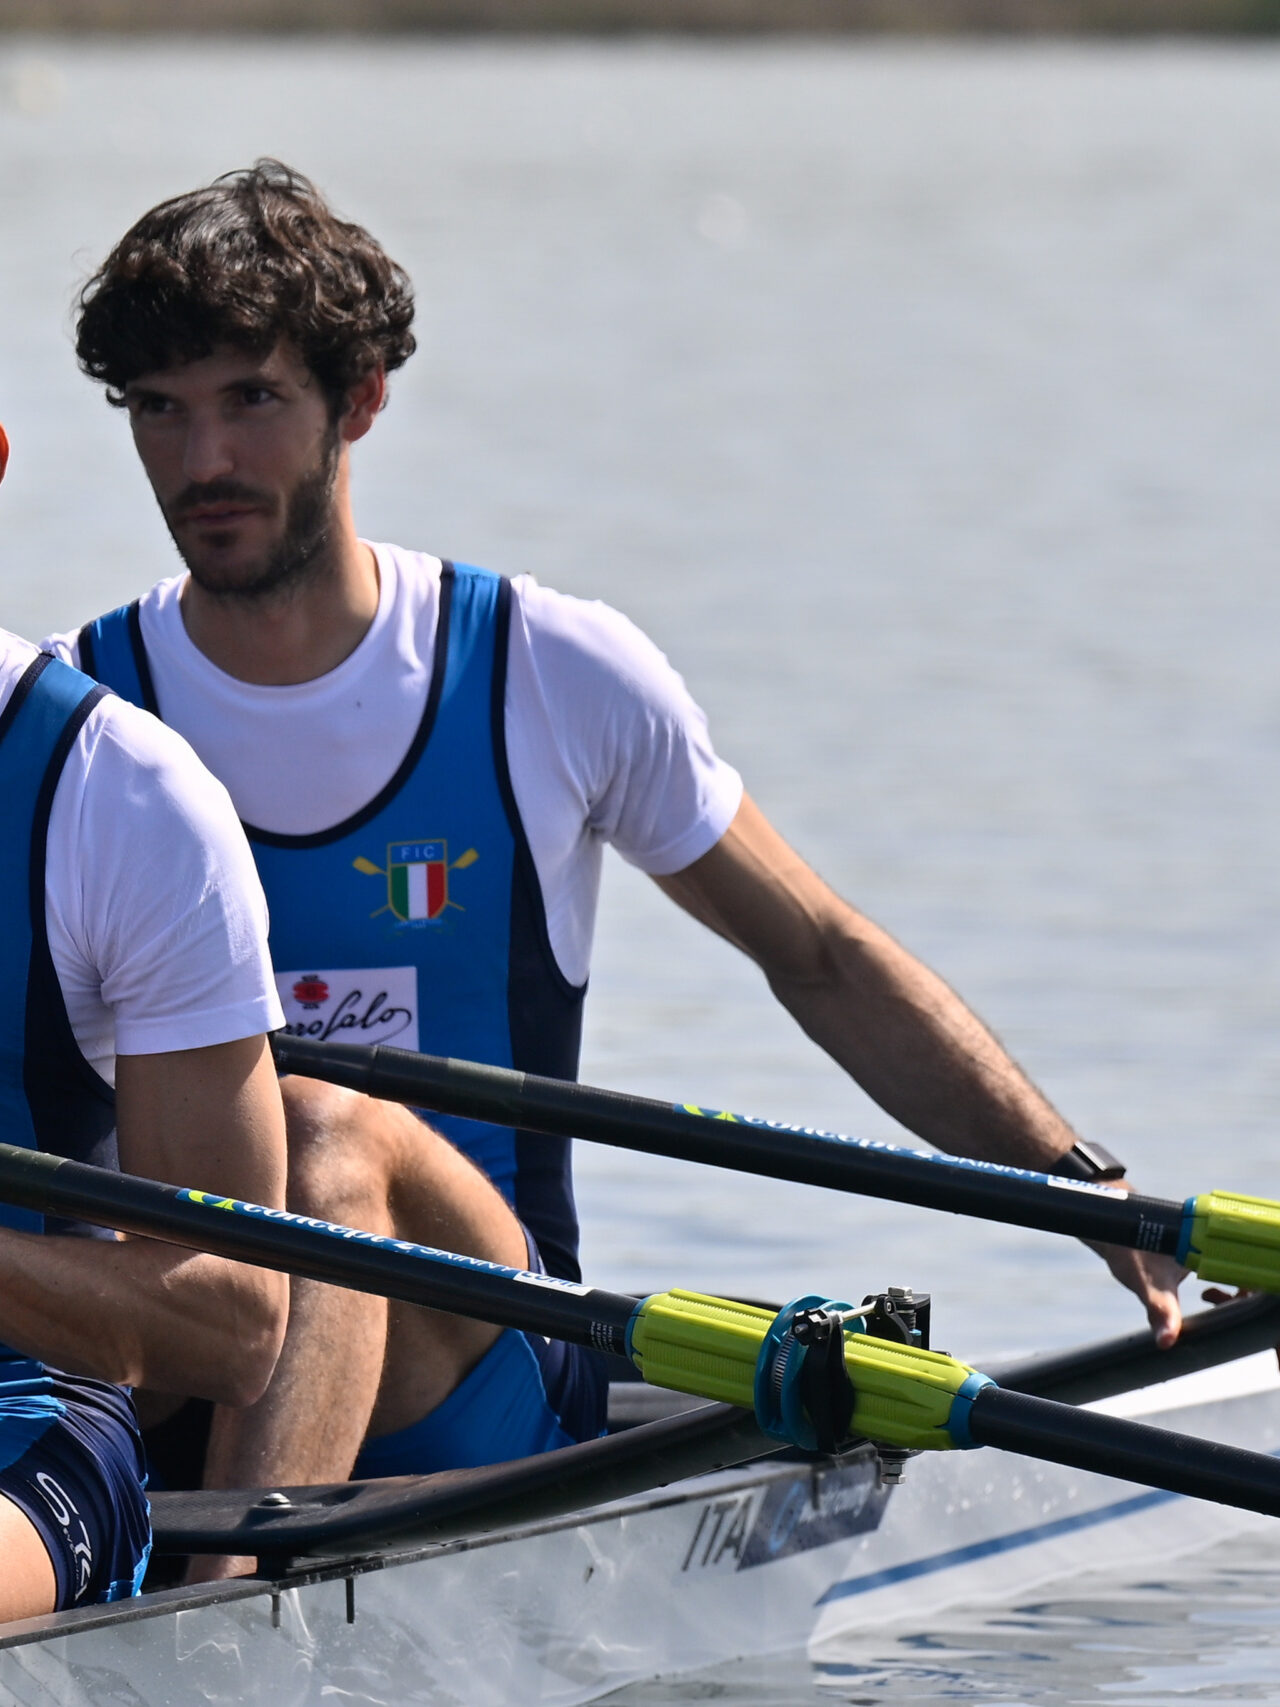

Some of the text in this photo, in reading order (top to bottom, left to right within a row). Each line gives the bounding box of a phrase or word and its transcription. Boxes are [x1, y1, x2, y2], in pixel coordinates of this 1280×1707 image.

[401, 845, 435, 860] FIC
[243, 1202, 386, 1243] concept
[416, 1244, 514, 1271] SKINNY
[681, 1493, 753, 1572] ITA
